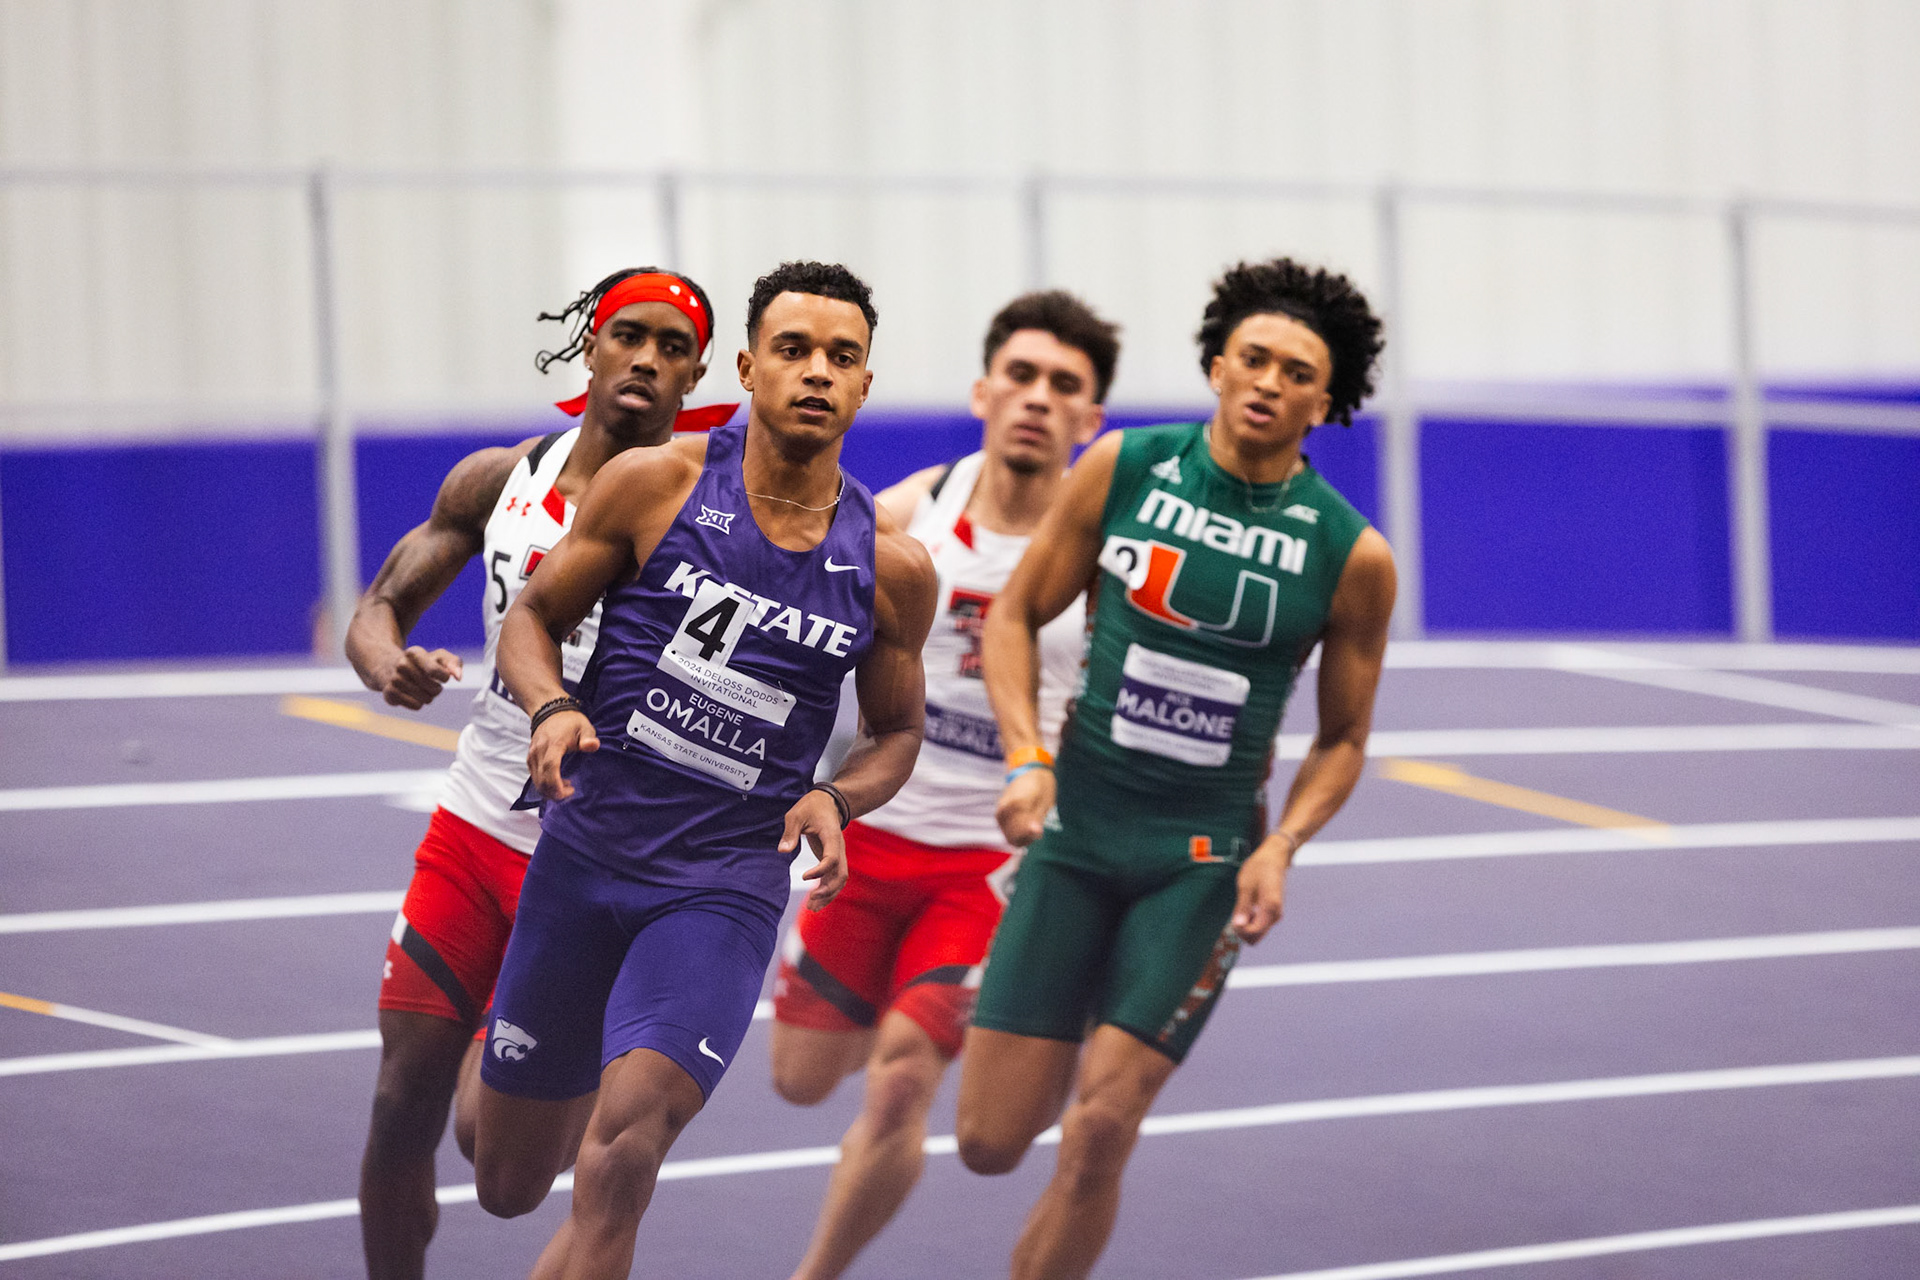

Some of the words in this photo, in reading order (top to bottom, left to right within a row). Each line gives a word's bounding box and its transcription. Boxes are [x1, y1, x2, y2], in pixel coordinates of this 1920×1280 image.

[491, 551, 512, 614] 5
[663, 560, 858, 658] KTATE
[684, 596, 740, 662] 4
[678, 657, 703, 674] 2024
[703, 669, 743, 692] DELOSS
[744, 686, 779, 705] DODDS
[688, 692, 744, 726] EUGENE
[690, 673, 758, 708] INVITATIONAL
[646, 687, 766, 761] OMALLA
[1115, 687, 1237, 739] MALONE
[640, 723, 672, 747] KANSAS
[673, 743, 699, 760] STATE
[699, 753, 748, 779] UNIVERSITY
